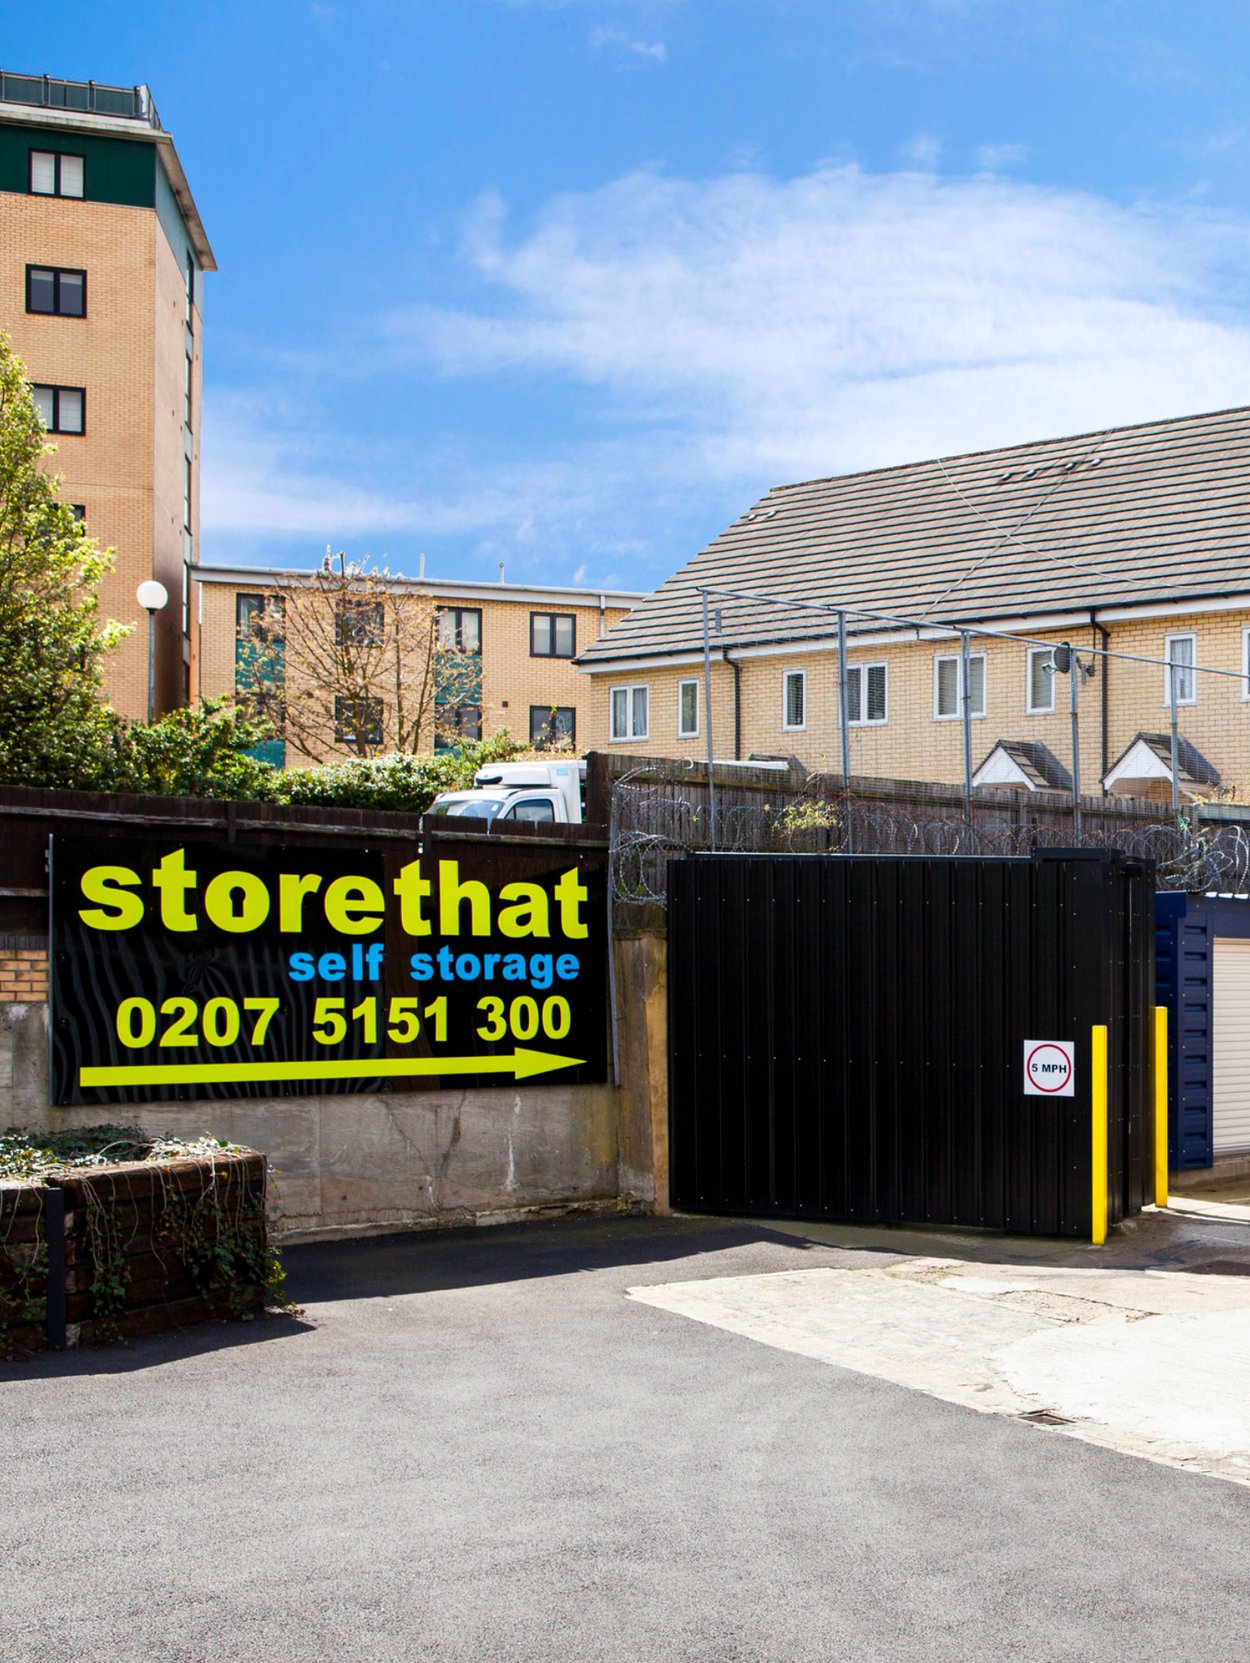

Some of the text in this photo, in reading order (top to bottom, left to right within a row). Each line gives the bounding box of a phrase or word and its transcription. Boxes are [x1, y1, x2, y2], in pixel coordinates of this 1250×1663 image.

[79, 848, 588, 938] storethat
[289, 944, 579, 989] self storage
[117, 996, 571, 1048] 0207 5151 300
[1031, 1063, 1067, 1074] 5 MPH
